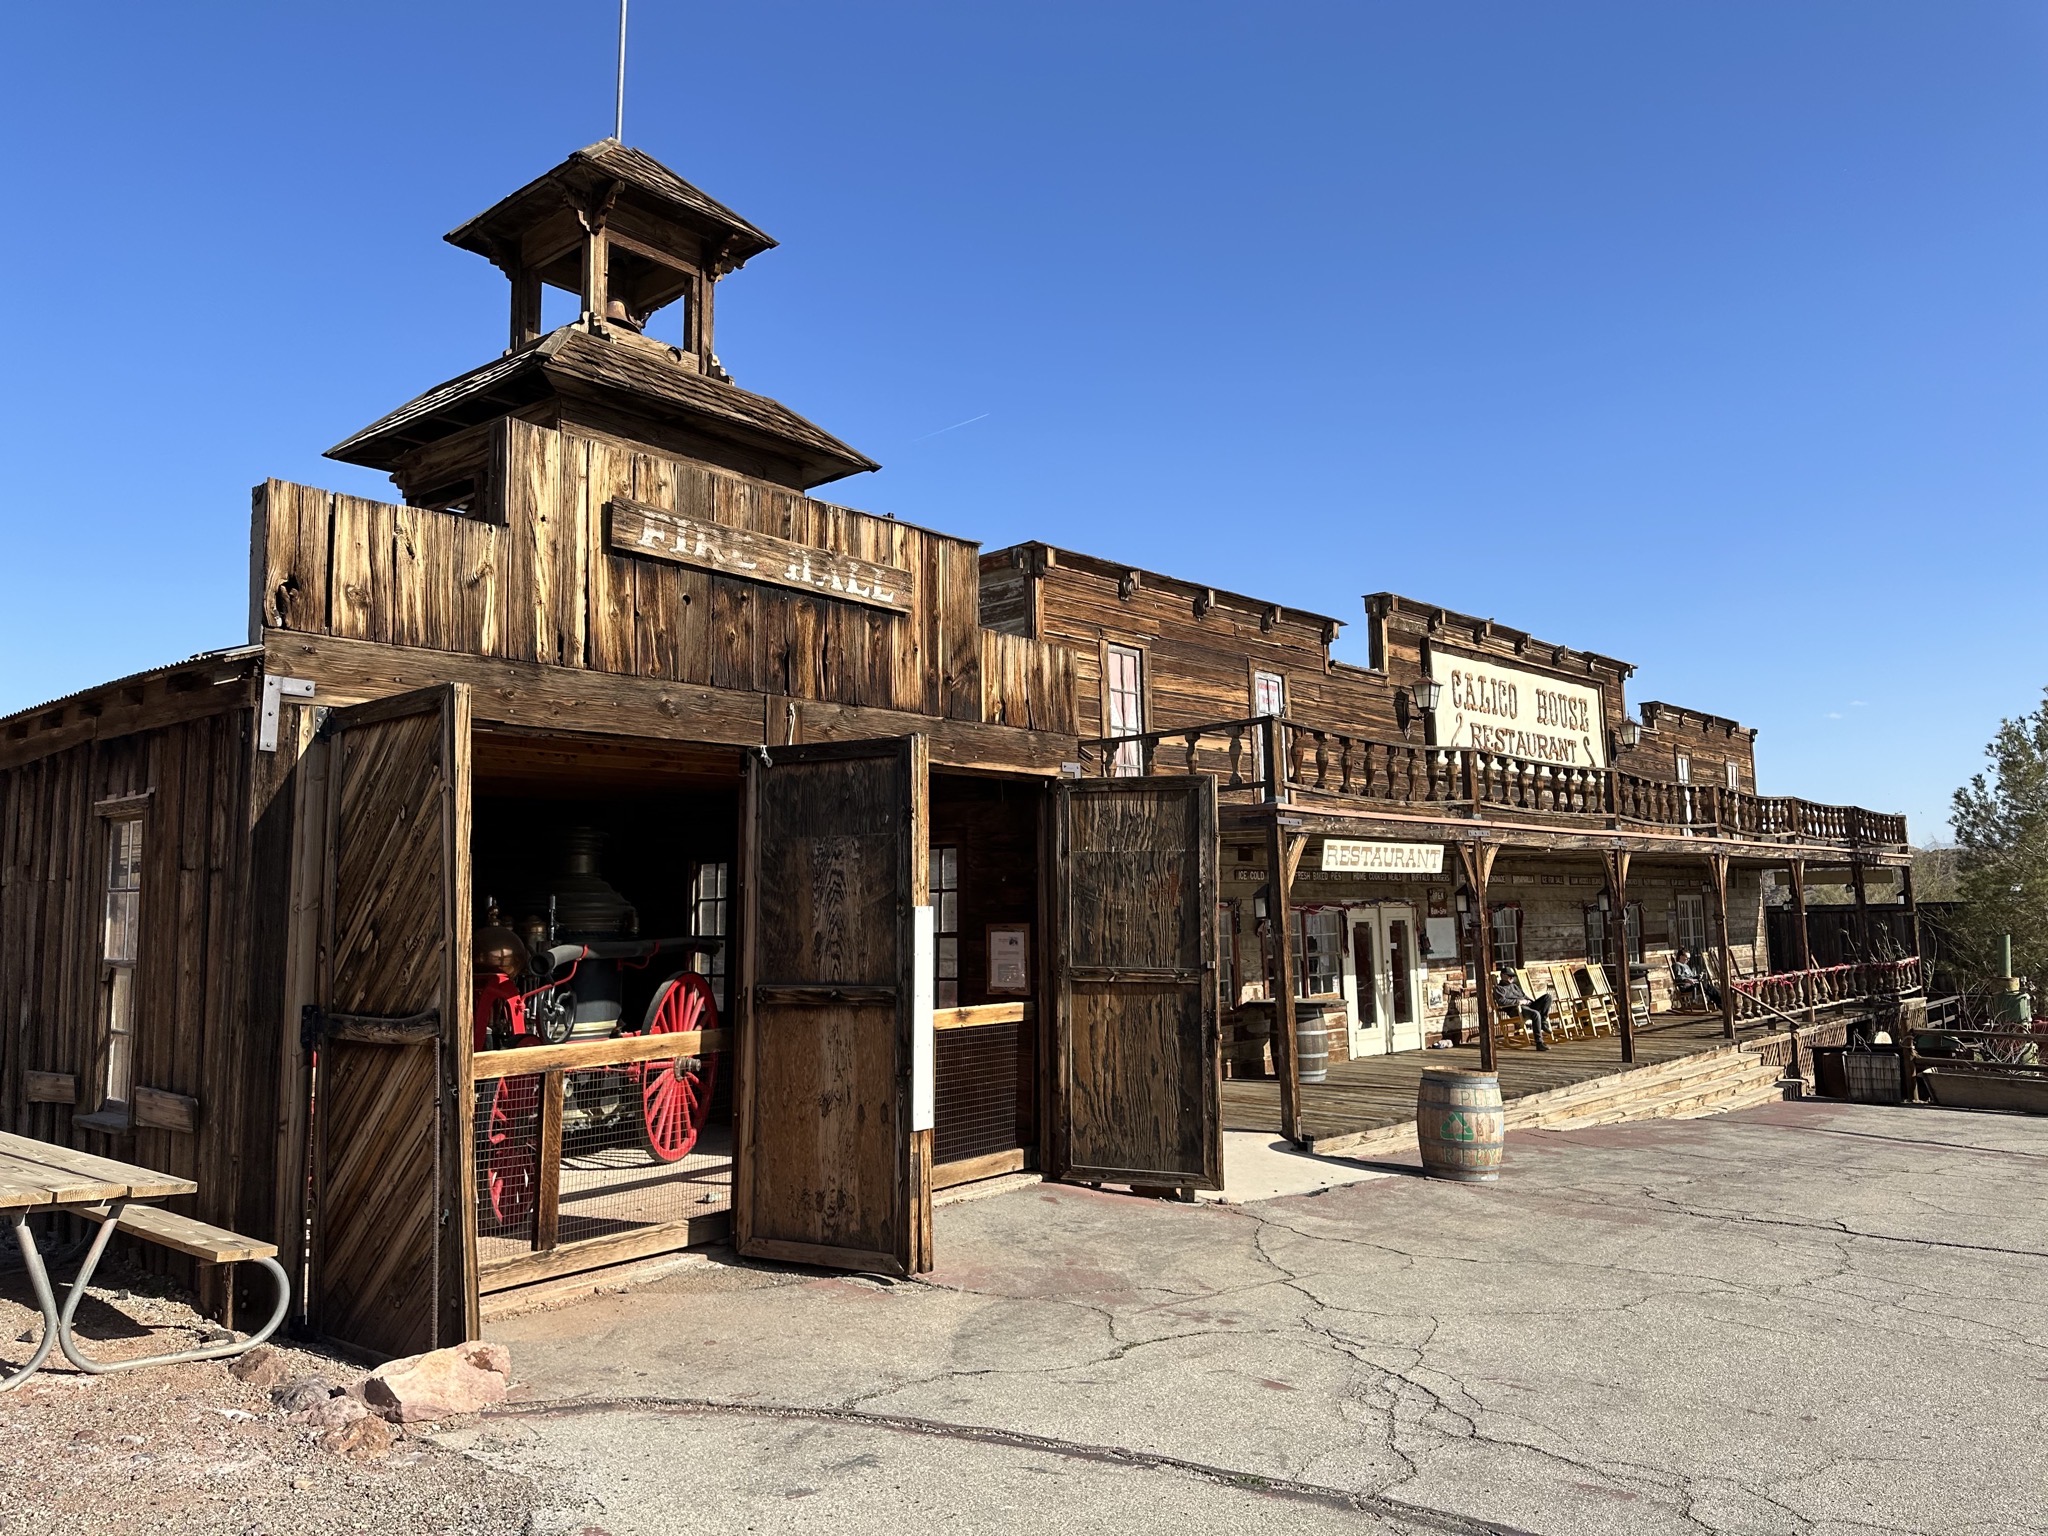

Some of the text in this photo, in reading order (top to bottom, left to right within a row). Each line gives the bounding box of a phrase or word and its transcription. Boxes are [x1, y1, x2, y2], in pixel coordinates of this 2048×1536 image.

[1451, 669, 1589, 733] CALICO HOUSE
[1470, 721, 1577, 764] RESTAURANT
[1325, 844, 1441, 869] RESTAURANT
[1238, 870, 1265, 881] ICE COLD
[1295, 871, 1342, 881] FRESH BAKED PIES
[1353, 872, 1367, 881] HOME
[1368, 872, 1387, 881] COOKED
[1411, 873, 1430, 882] BUFFALO
[1432, 873, 1450, 882] BURGERS
